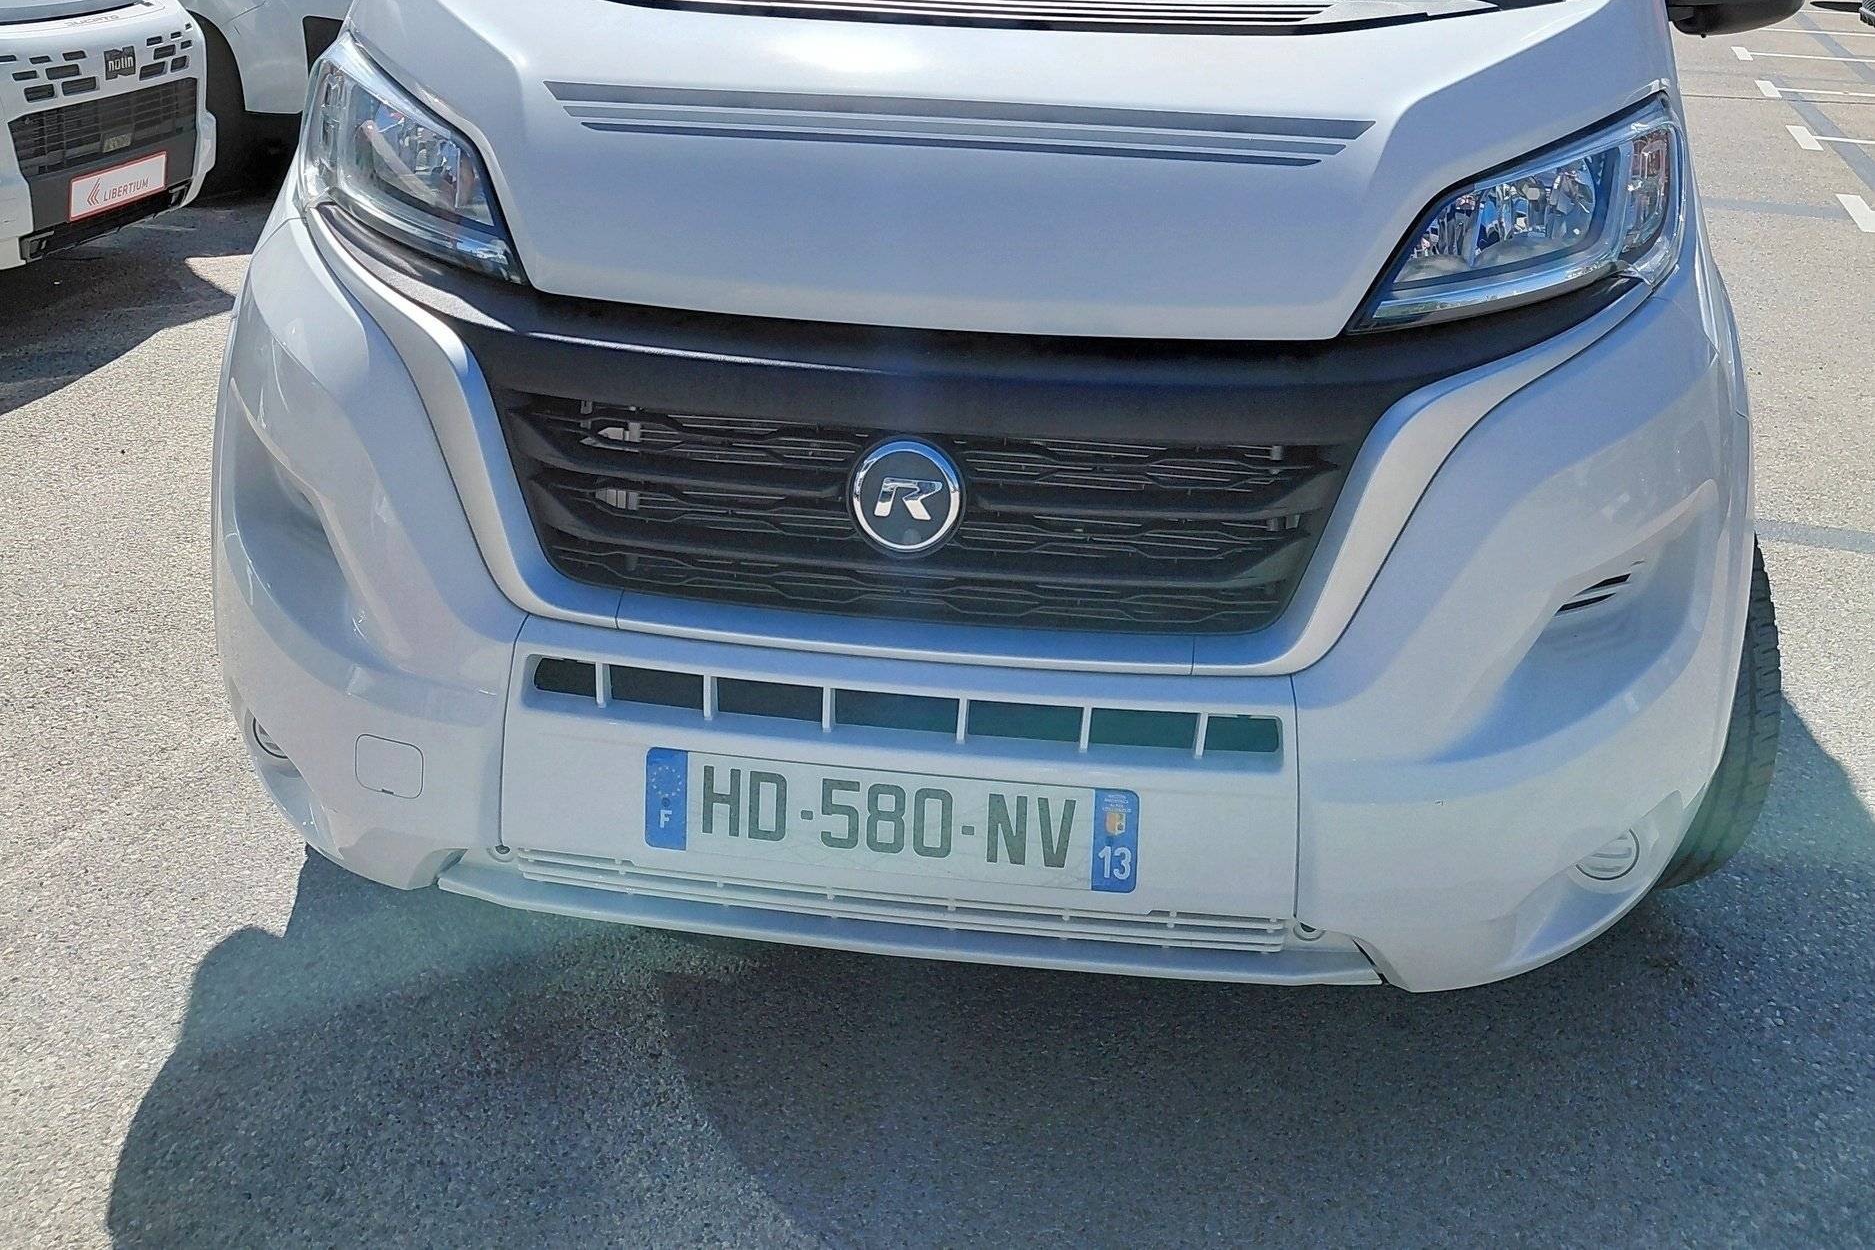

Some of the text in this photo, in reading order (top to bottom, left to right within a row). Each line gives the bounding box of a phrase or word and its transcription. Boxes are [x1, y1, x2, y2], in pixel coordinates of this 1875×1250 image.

[108, 56, 134, 71] nolin
[103, 175, 150, 202] LIBERTIUM
[873, 476, 943, 521] R
[659, 809, 672, 829] F
[701, 764, 1077, 868] HD-580-NV
[1098, 845, 1132, 880] 13
